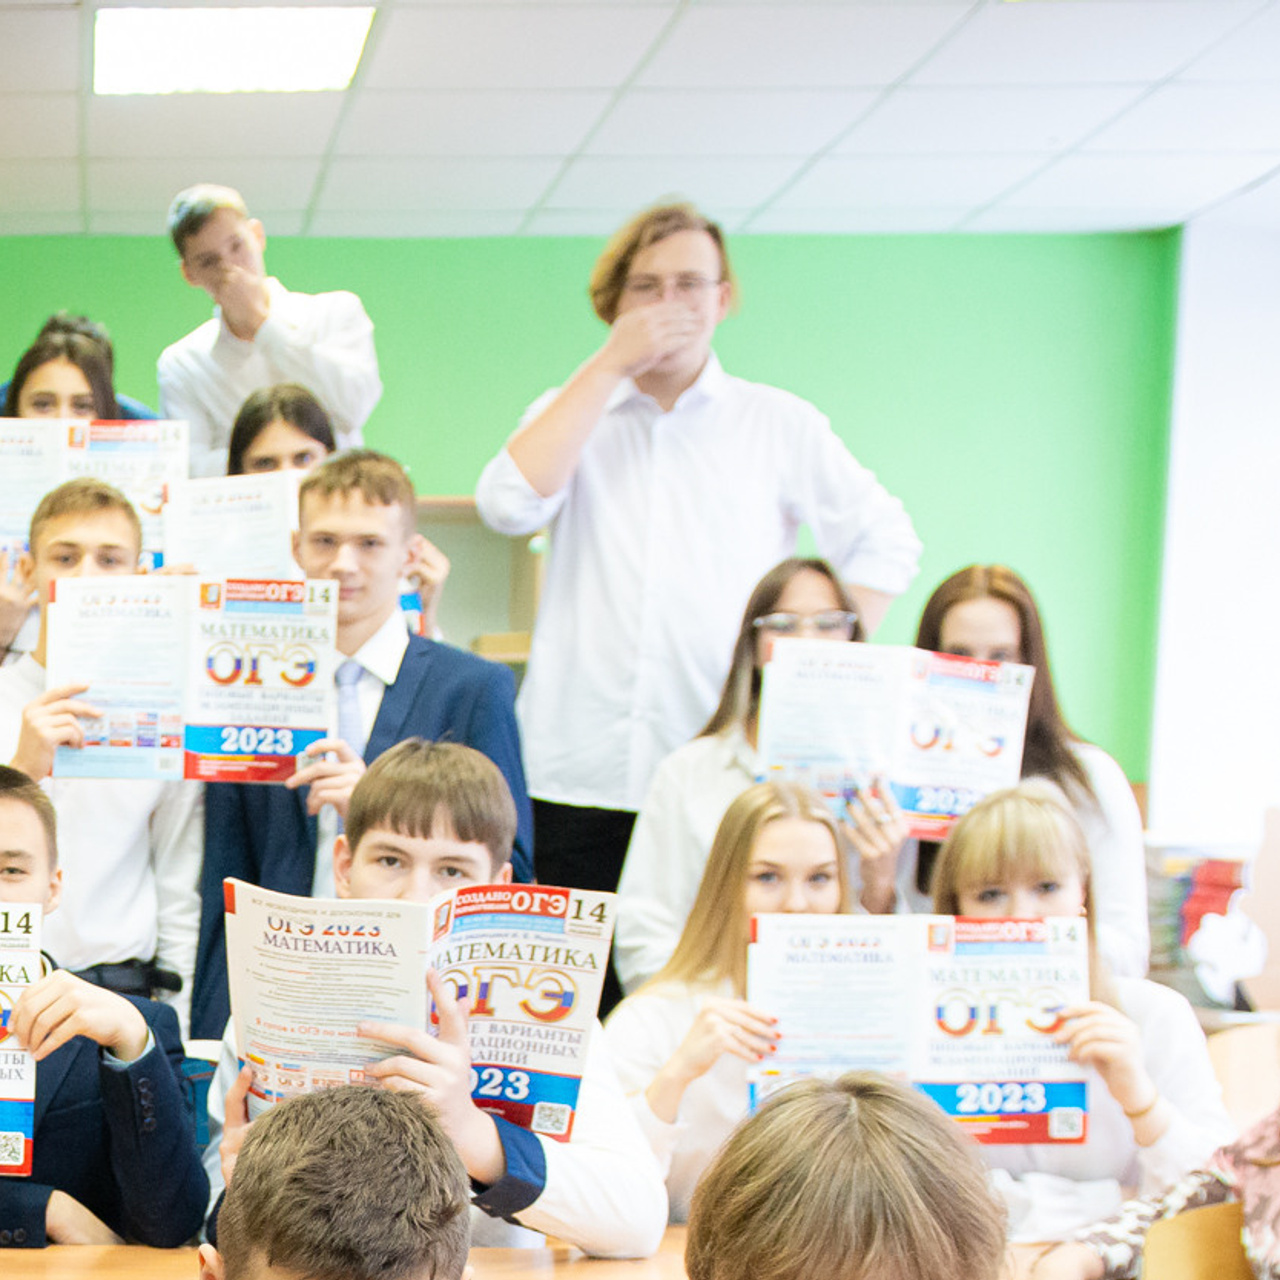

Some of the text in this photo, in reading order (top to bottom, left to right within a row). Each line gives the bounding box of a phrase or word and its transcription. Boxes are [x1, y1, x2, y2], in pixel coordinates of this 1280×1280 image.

[308, 587, 331, 603] 14
[205, 641, 317, 687] ОГЭ
[221, 726, 294, 755] 2023
[511, 892, 567, 915] ОГЭ
[571, 899, 608, 923] 14
[1, 911, 32, 934] 14
[322, 921, 381, 937] 2023
[263, 932, 397, 957] МАТЕМАТИКА
[935, 987, 1068, 1037] ОГЭ
[489, 1023, 583, 1045] ВАРИАНТЫ
[955, 1083, 1047, 1114] 2023
